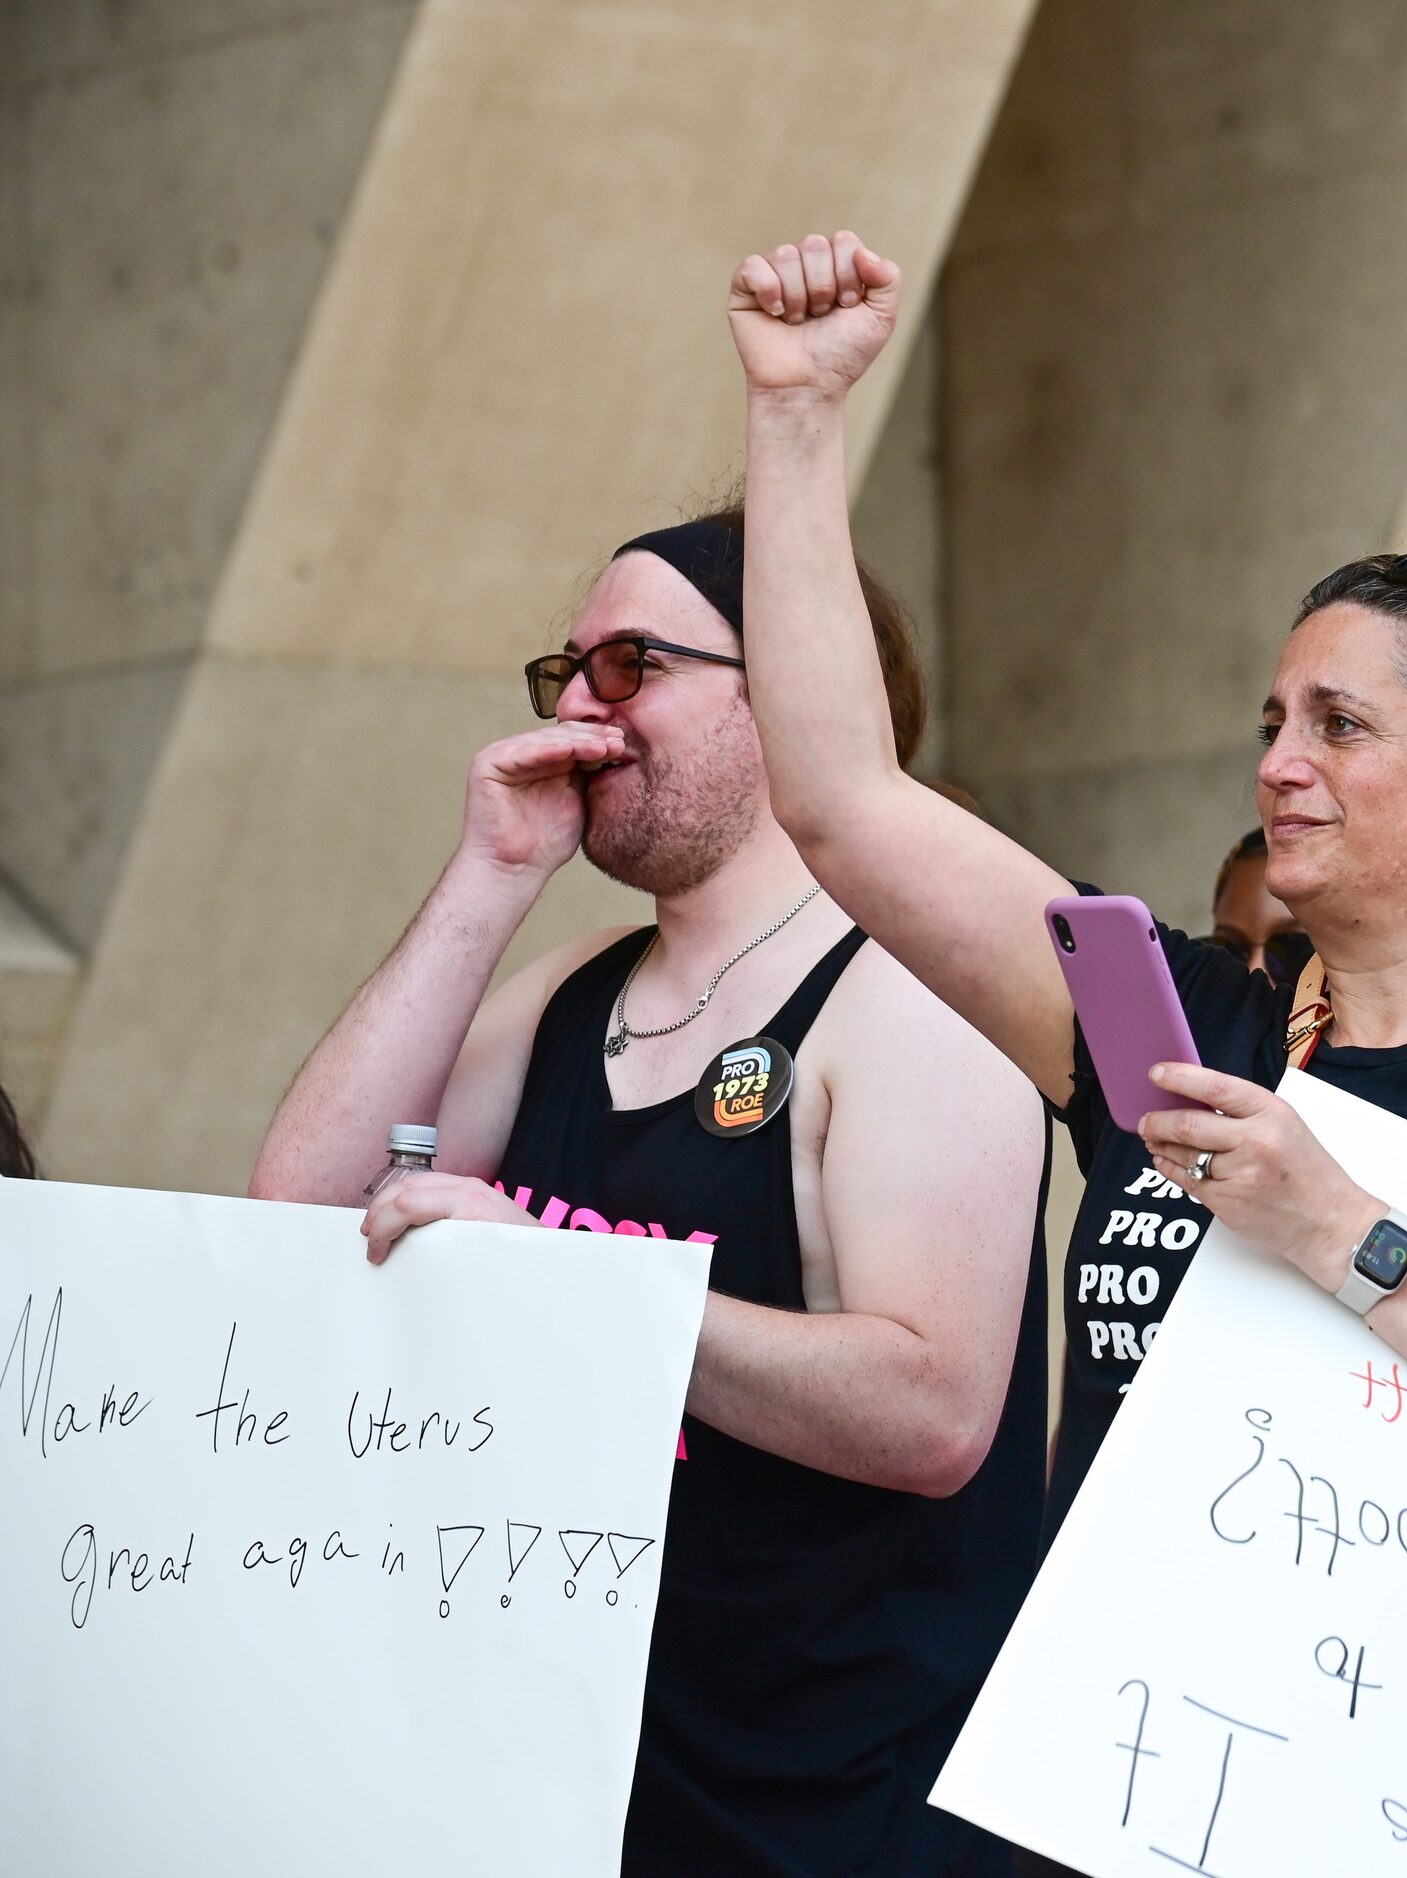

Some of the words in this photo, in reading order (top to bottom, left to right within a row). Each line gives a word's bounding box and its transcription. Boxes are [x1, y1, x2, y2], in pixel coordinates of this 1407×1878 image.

[712, 1072, 770, 1101] 1973
[721, 1060, 755, 1081] PRO
[730, 1092, 765, 1112] ROE
[1123, 1166, 1203, 1205] PR
[1098, 1209, 1200, 1250] PRO
[1077, 1263, 1160, 1305] PRO
[195, 1321, 292, 1453] the
[347, 1387, 497, 1459] Uterus
[61, 1522, 195, 1629] great
[1315, 1636, 1383, 1718] to
[1115, 1679, 1289, 1878] It
